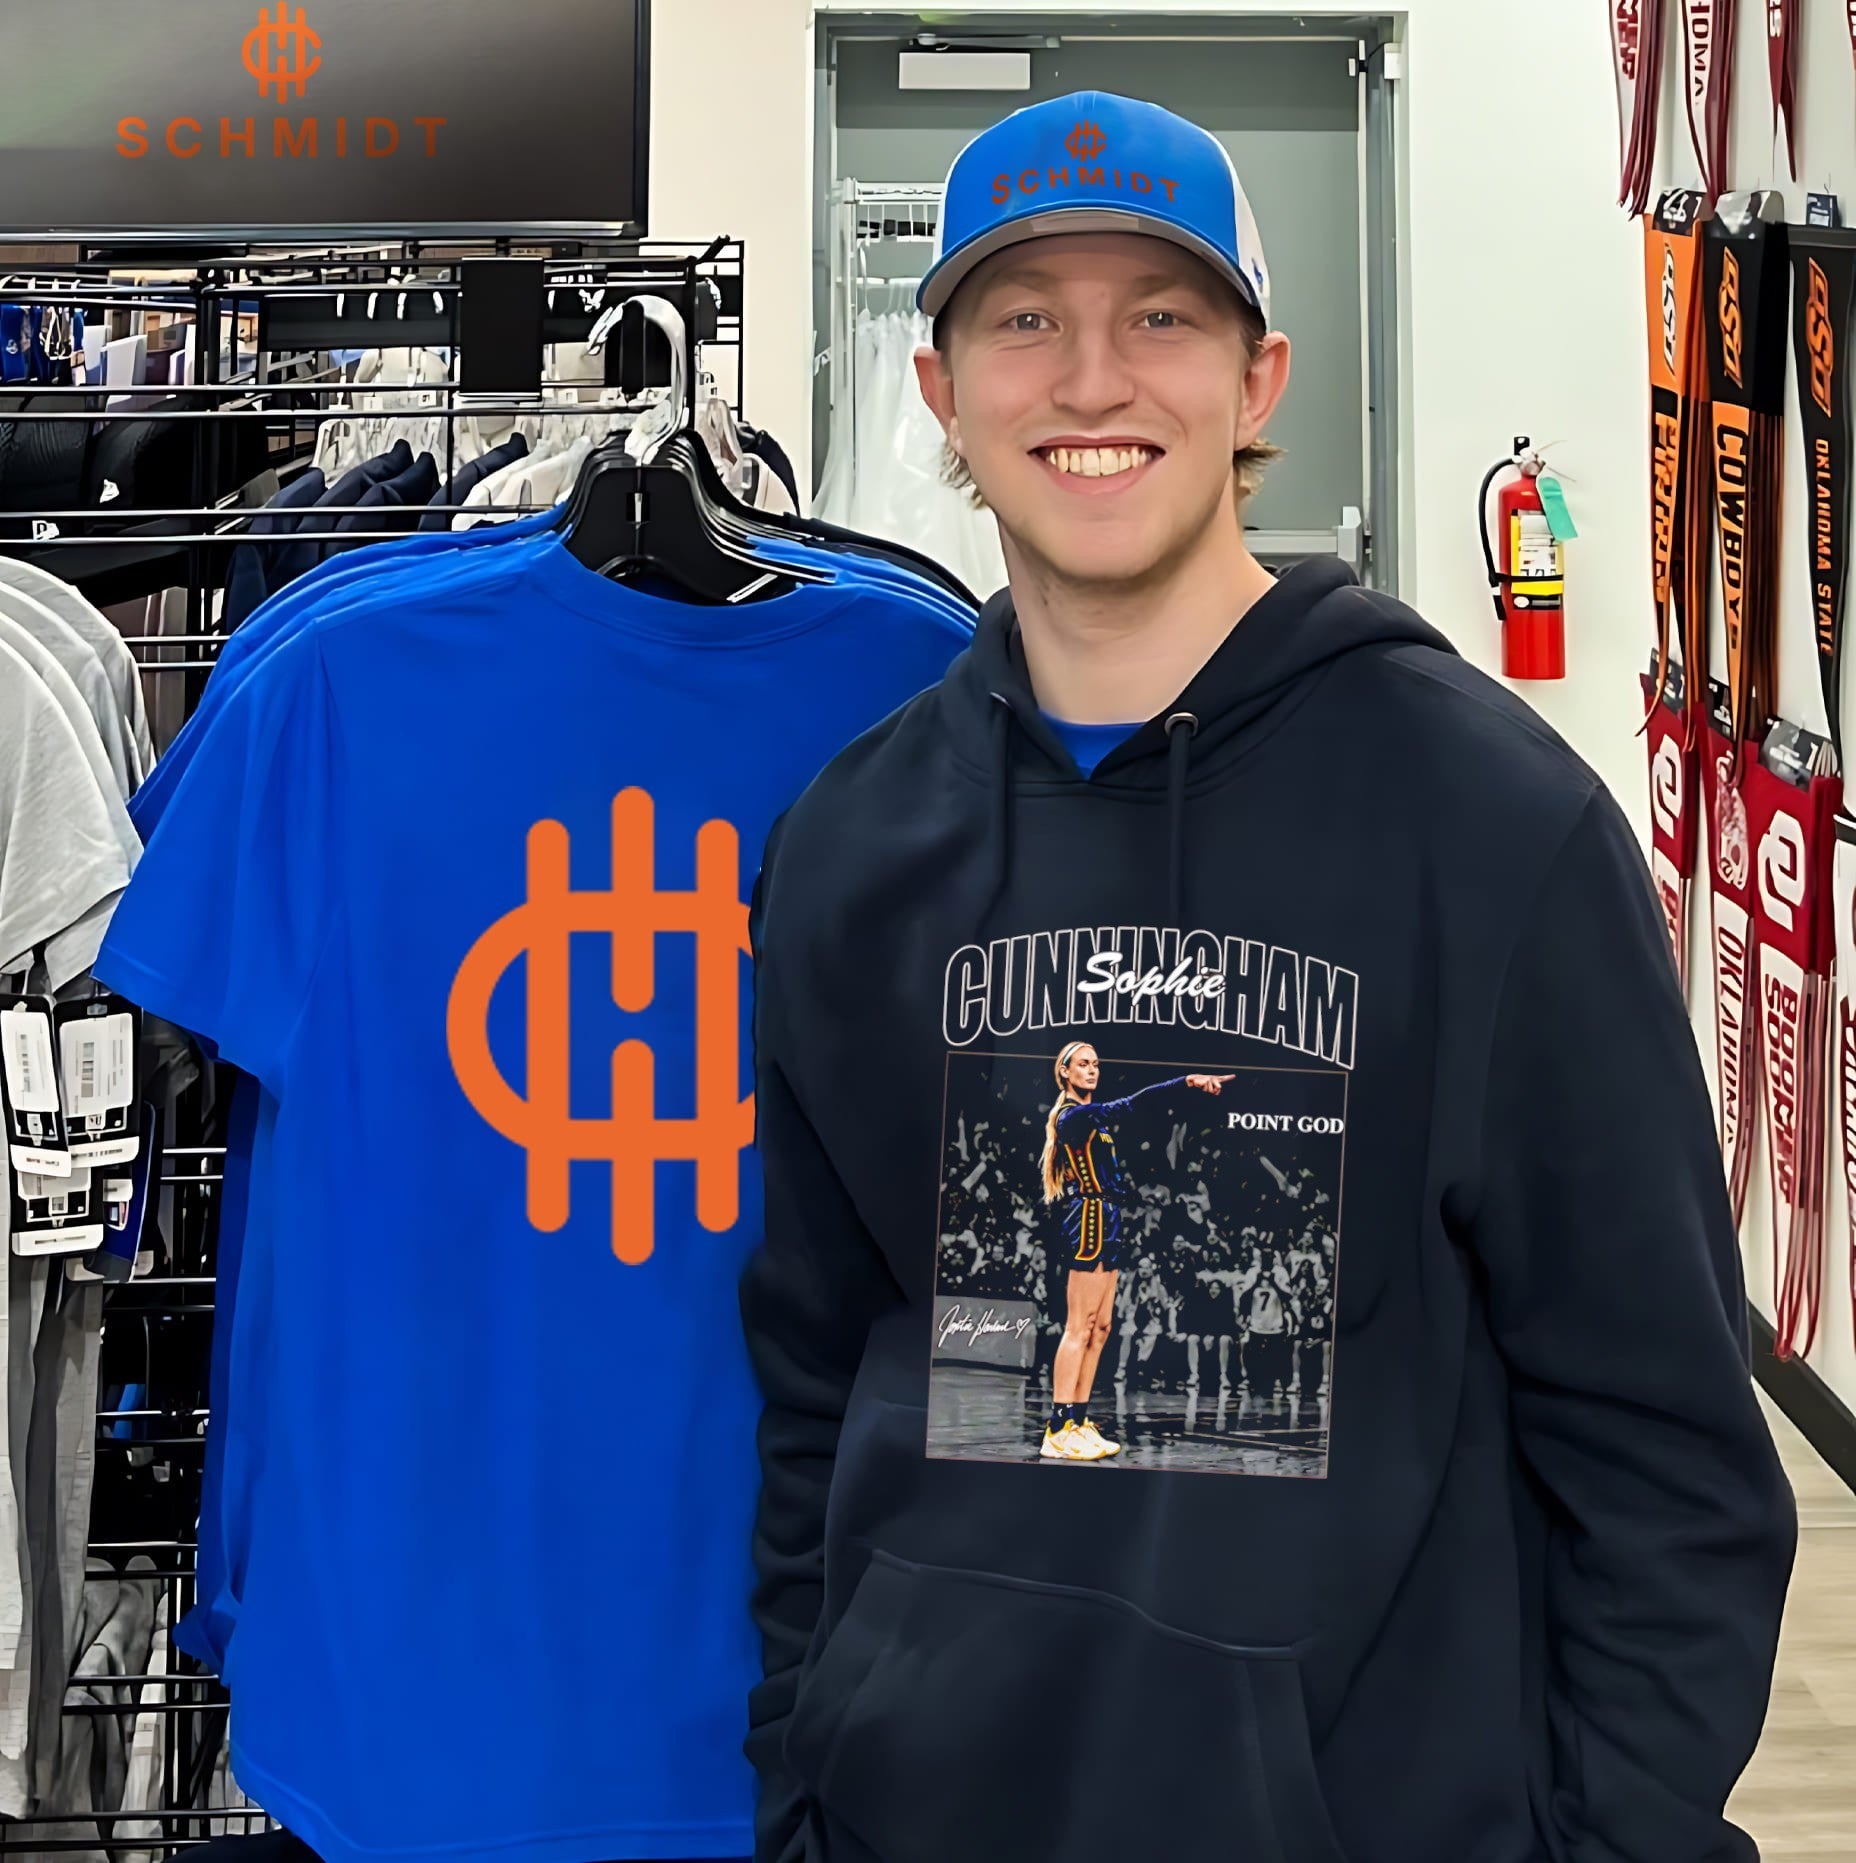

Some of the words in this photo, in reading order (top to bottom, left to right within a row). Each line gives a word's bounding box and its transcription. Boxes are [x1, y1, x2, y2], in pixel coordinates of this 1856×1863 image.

[117, 117, 446, 158] SCHMIDT
[992, 167, 1179, 205] SCHMIDT
[1816, 439, 1832, 570] OKLAHOMA
[943, 927, 1358, 1070] CUNNINGHAM
[1078, 952, 1226, 1006] Sophie
[1718, 926, 1744, 1144] OKLAHOMA
[1228, 1113, 1293, 1133] POINT
[1297, 1114, 1344, 1135] GOD
